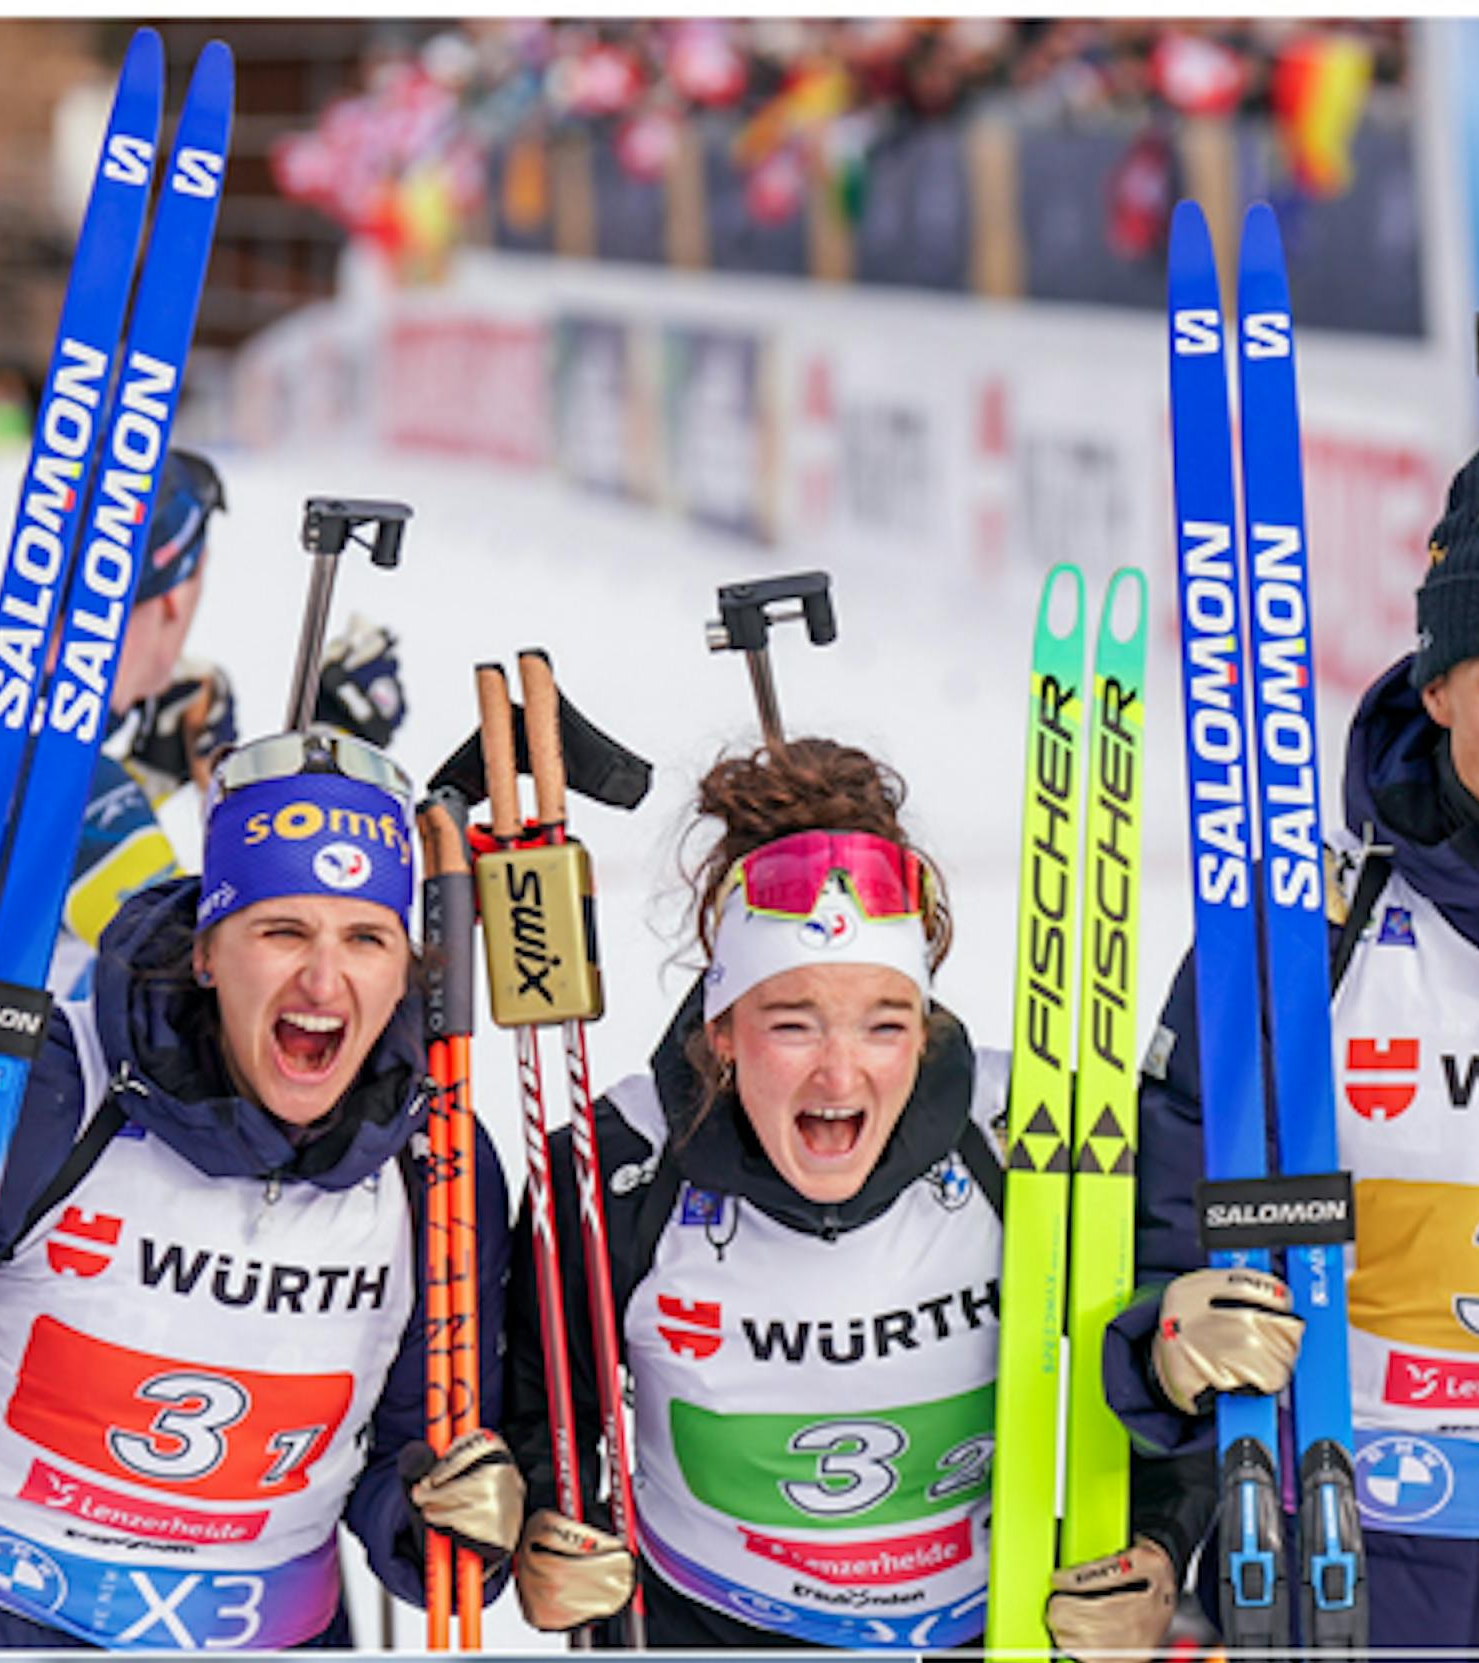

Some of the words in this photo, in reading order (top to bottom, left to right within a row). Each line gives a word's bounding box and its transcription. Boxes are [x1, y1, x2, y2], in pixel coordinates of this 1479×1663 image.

[48, 351, 177, 744] SALOMON
[1183, 519, 1249, 910] SALOMON
[1252, 523, 1323, 912] SALOMON
[1025, 671, 1076, 1072] FISCHER
[1090, 674, 1138, 1073] FISCHER
[1205, 1200, 1348, 1229] SALOMON
[108, 1370, 251, 1482] 3
[258, 1424, 328, 1487] 1
[778, 1416, 910, 1520] 3
[924, 1432, 994, 1503] 2
[80, 1489, 246, 1542] Lenzerheide
[796, 1536, 961, 1577] enzerheide
[119, 1568, 265, 1650] X3
